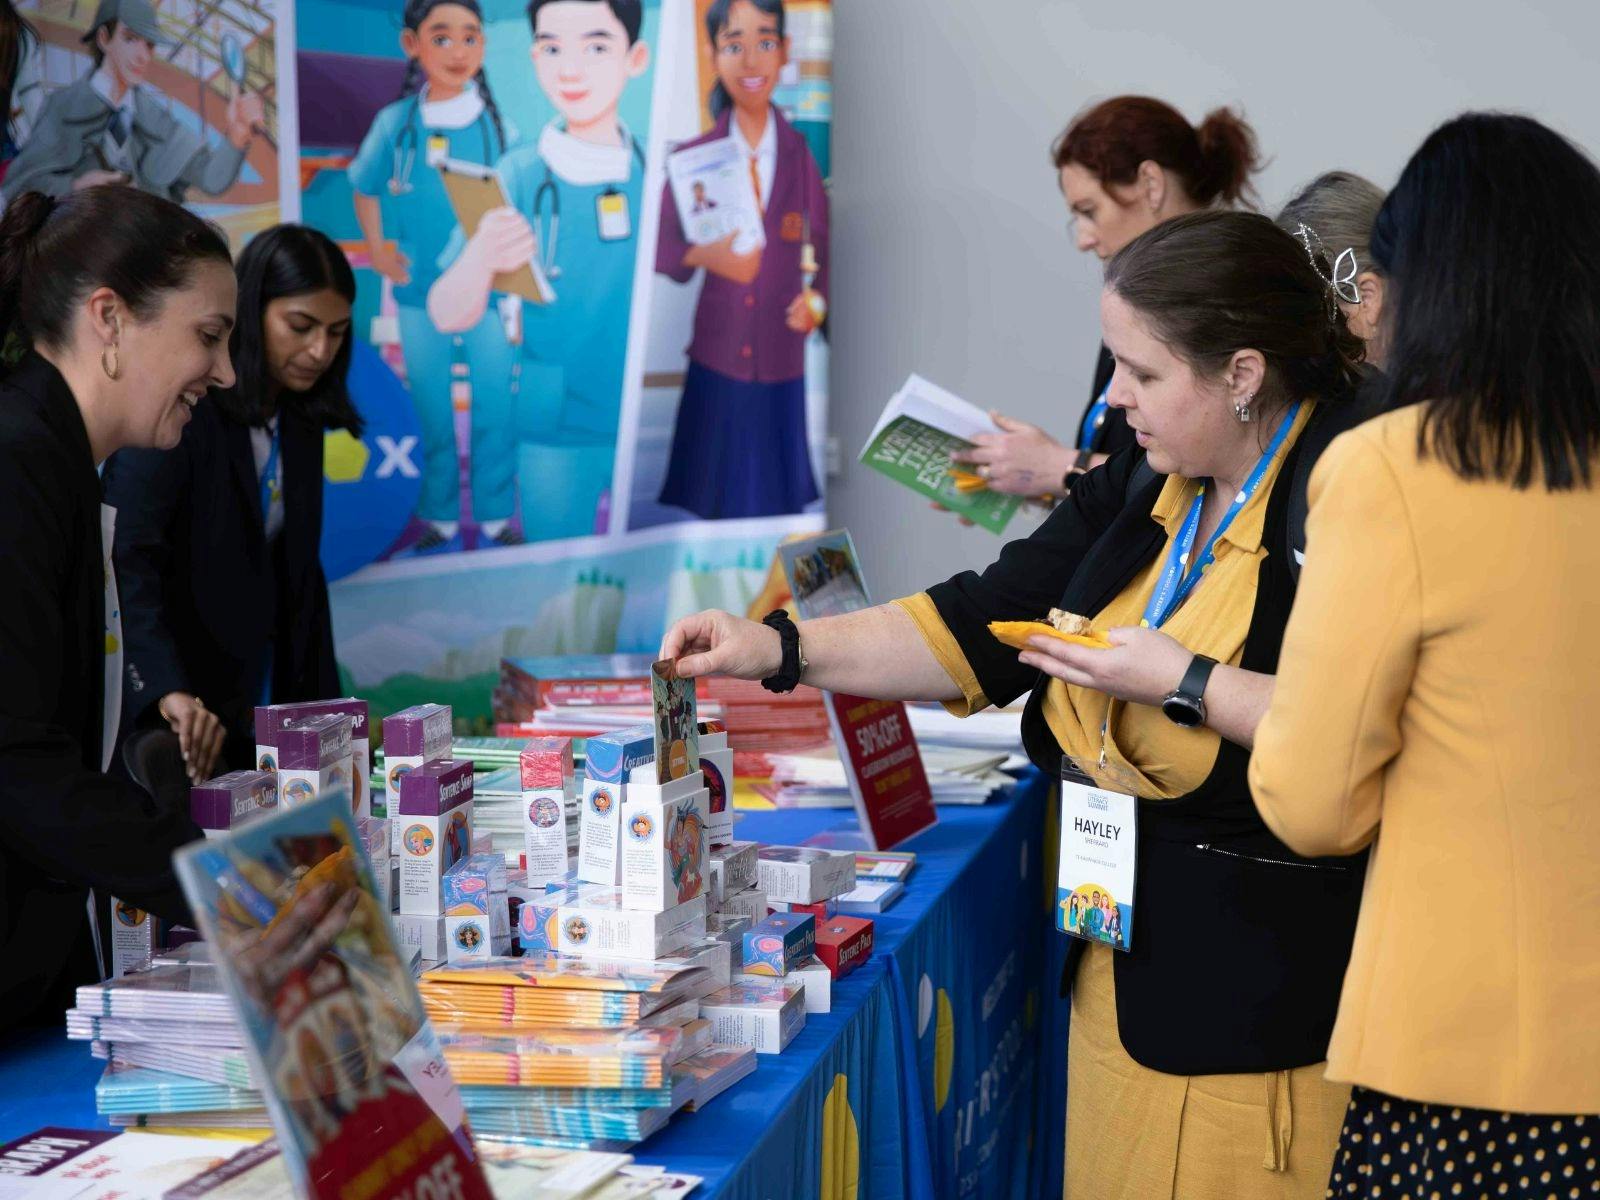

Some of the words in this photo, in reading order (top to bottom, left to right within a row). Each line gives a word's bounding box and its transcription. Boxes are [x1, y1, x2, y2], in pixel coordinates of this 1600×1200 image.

[440, 780, 460, 802] SENTENCE
[460, 772, 473, 793] SNAP
[1074, 816, 1121, 841] HAYLEY
[839, 942, 860, 966] SENTENCE
[859, 933, 872, 951] PACK
